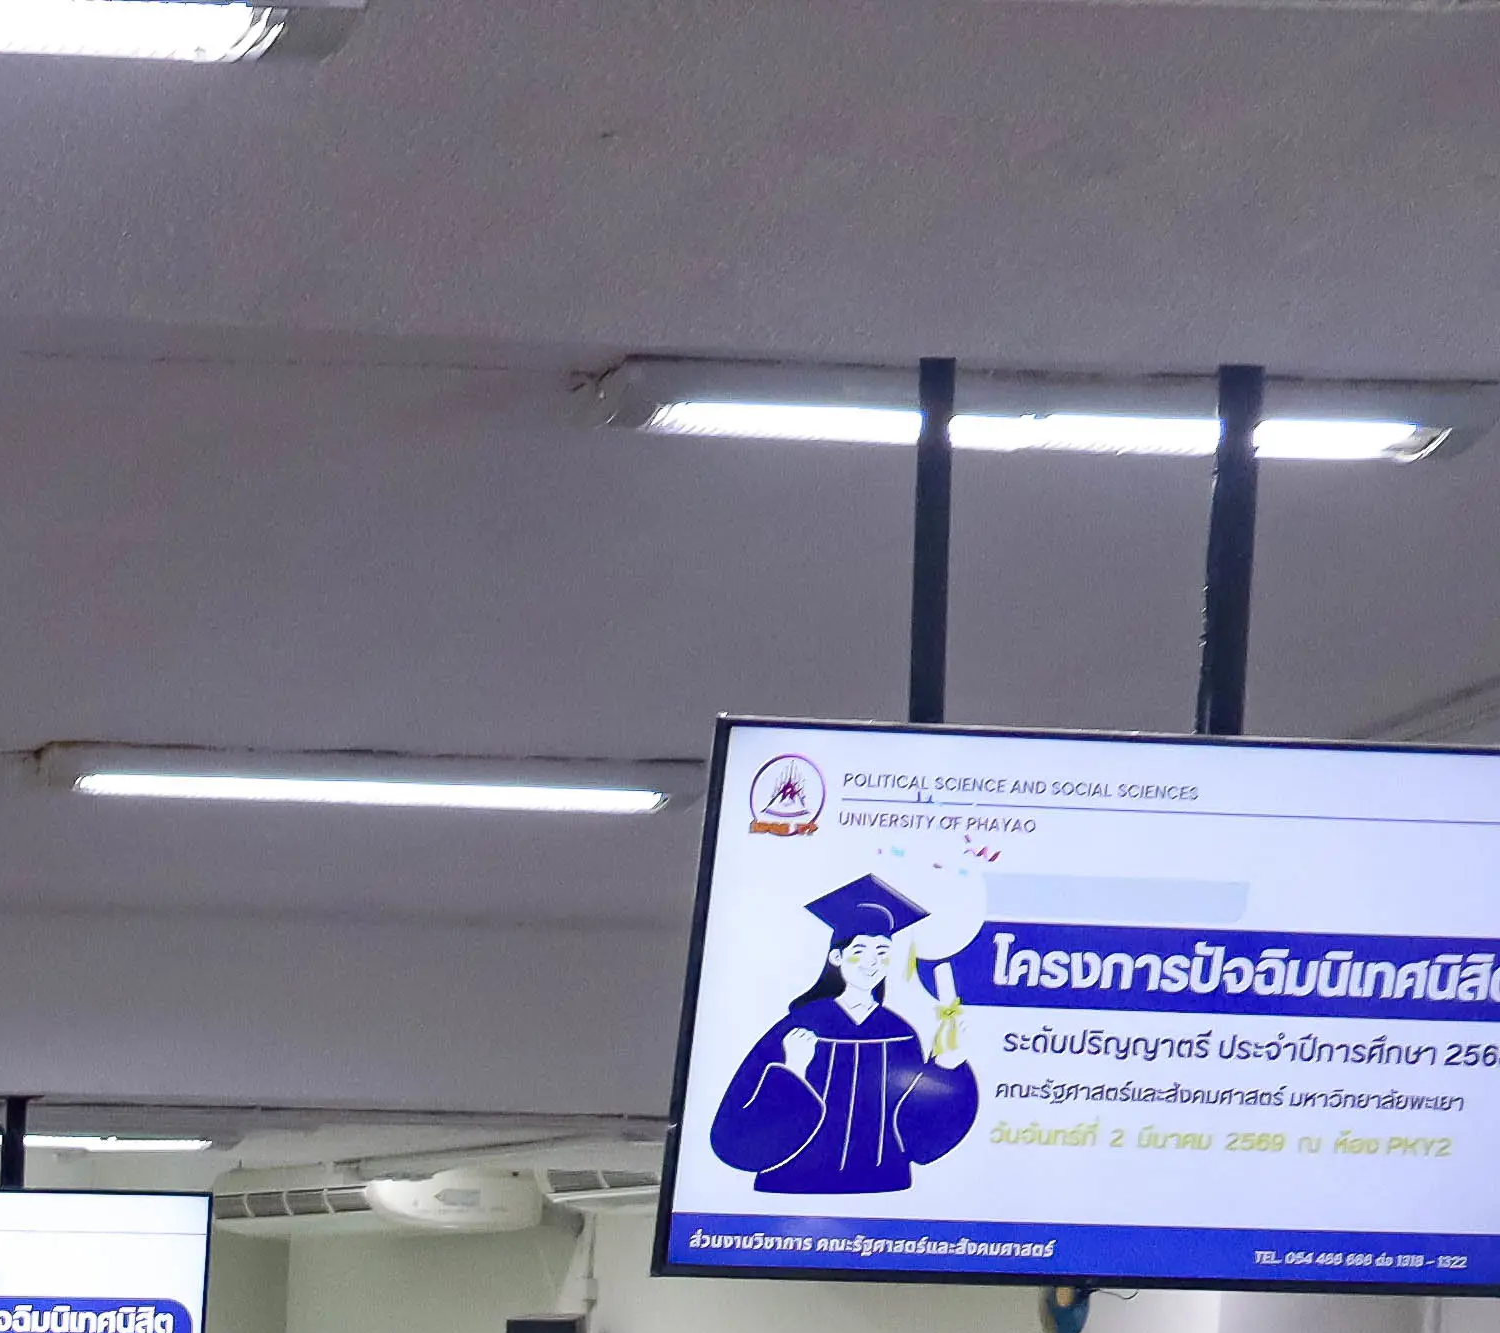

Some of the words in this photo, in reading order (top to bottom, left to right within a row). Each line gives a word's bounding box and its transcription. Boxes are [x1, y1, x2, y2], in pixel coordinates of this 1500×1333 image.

[843, 772, 929, 791] POLITICAL
[935, 776, 1006, 794] SCIENCE
[1010, 779, 1046, 795] AND
[1052, 780, 1112, 798] SOCIAL
[1118, 783, 1199, 801] SCIENCES
[839, 811, 934, 831] UNIVERSITY
[940, 815, 962, 831] OF
[967, 816, 1036, 834] PHAYAO
[1003, 1026, 1211, 1062] ระดับปริญญาตรี
[1219, 1032, 1436, 1067] ประจำปีการศึกษา
[996, 1079, 1286, 1107] คณะรัฐศาสตร์และสังคมศาสตร์
[1290, 1088, 1464, 1113] มหาวิทยาลัยพะเยา
[1109, 1130, 1125, 1148] 2
[690, 1229, 812, 1251] ส่วนงานวิชาการ
[817, 1235, 1055, 1258] คณะรัฐศาสตร์และสังคมศาสตร์
